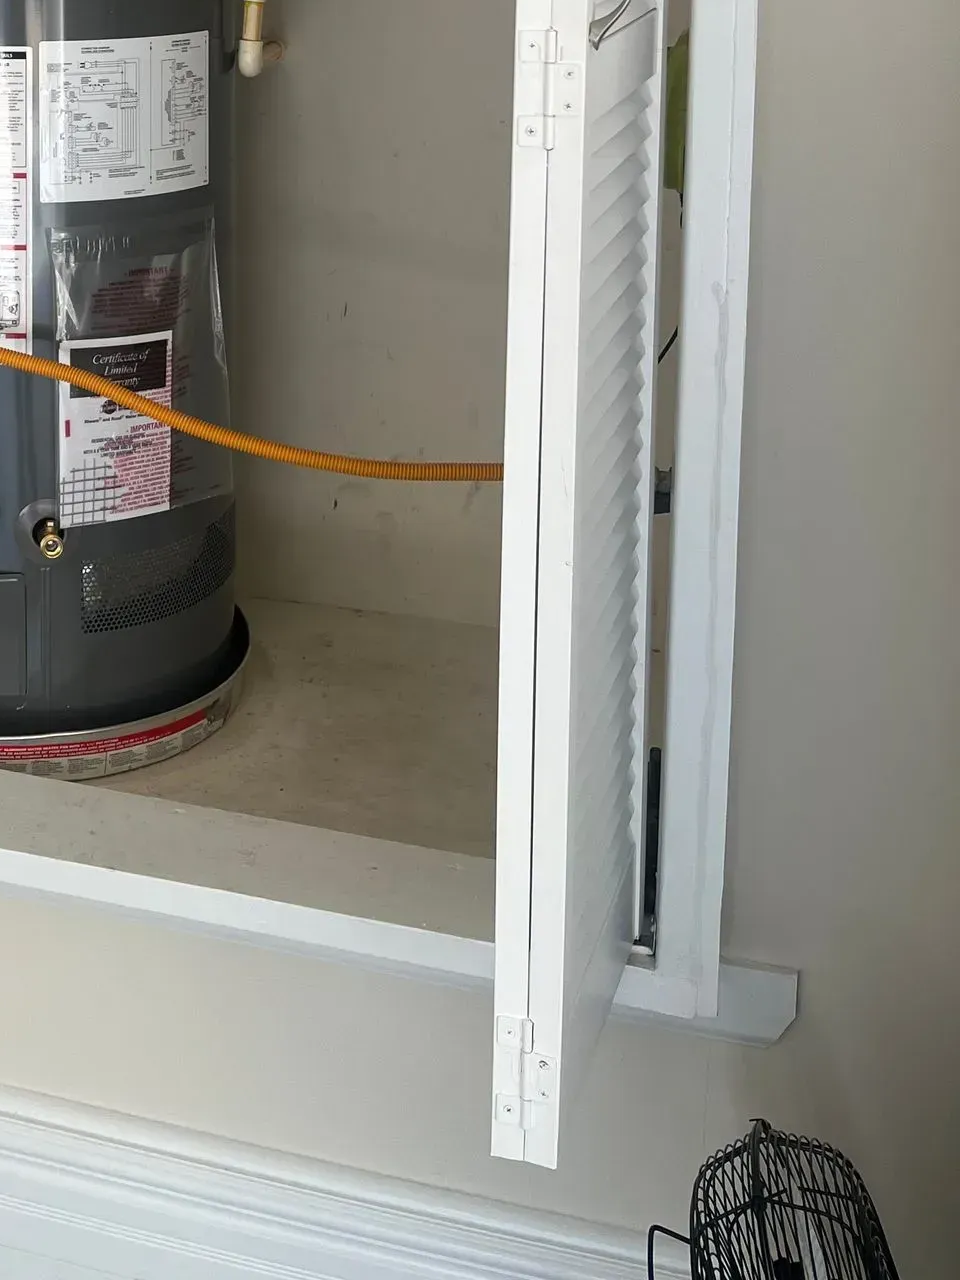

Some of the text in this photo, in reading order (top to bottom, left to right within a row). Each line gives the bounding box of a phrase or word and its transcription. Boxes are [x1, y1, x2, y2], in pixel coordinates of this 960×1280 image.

[92, 348, 150, 365] Certificate of
[104, 363, 138, 376] Limited
